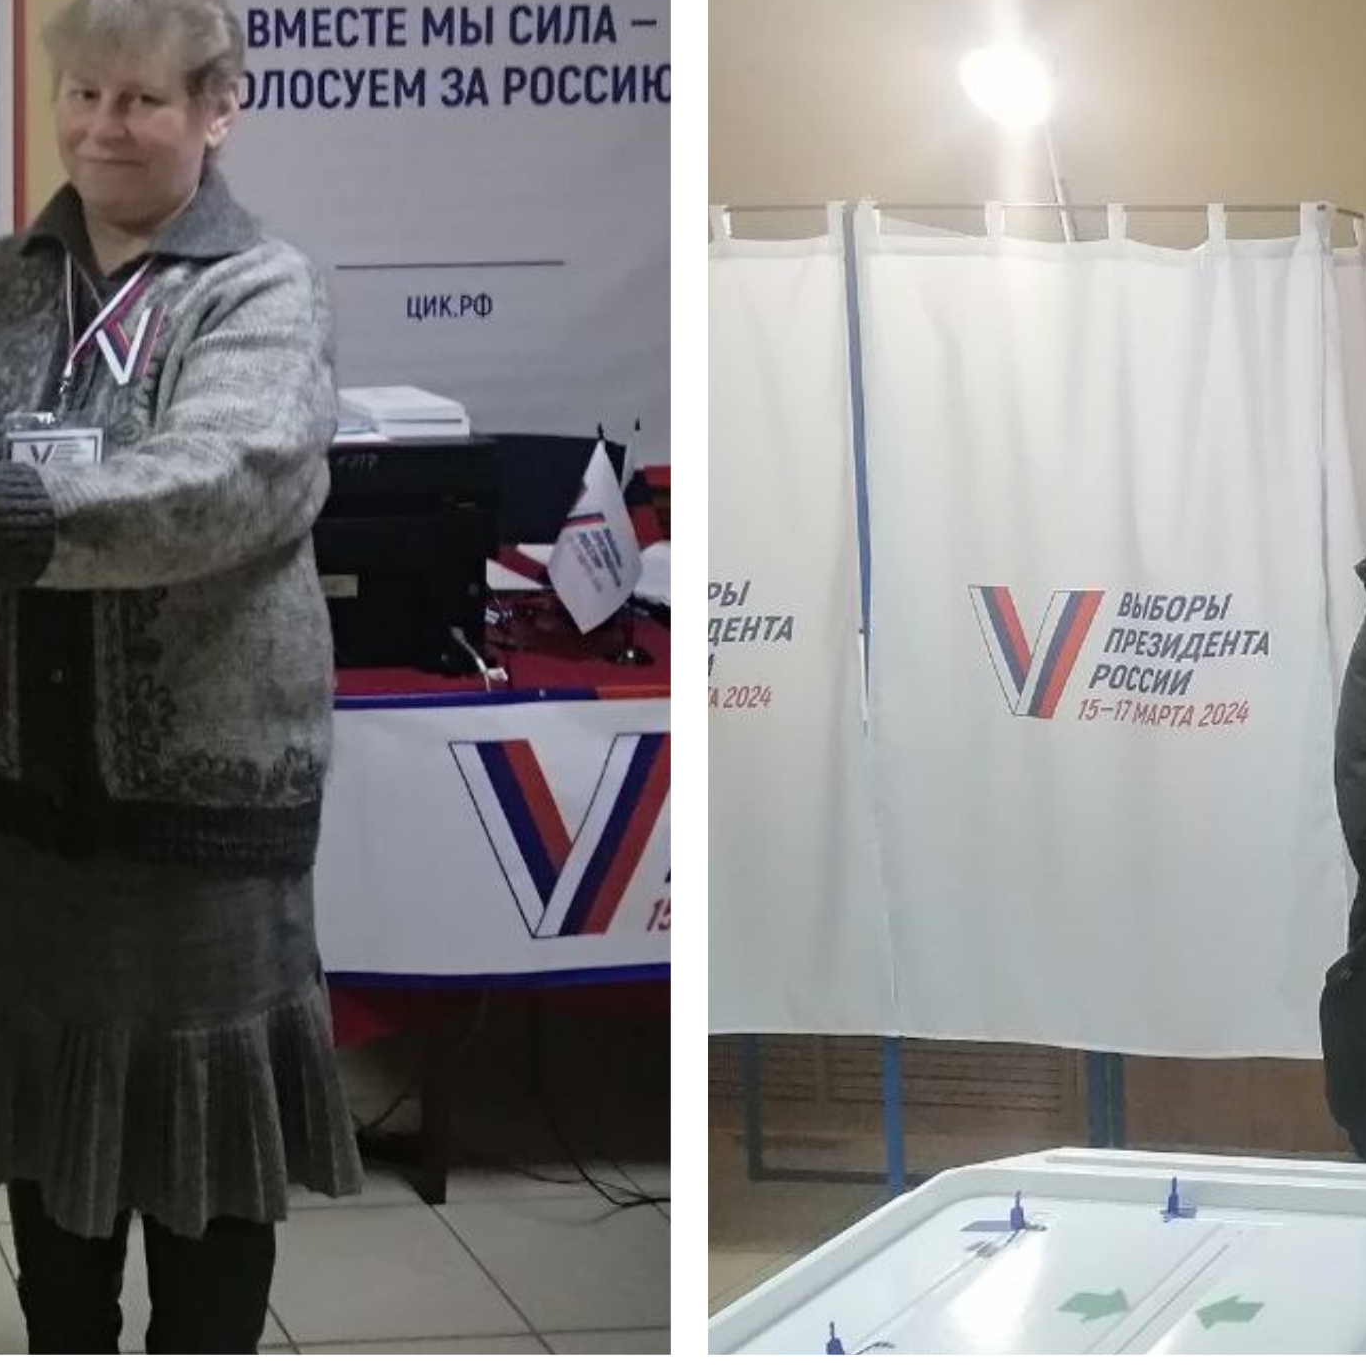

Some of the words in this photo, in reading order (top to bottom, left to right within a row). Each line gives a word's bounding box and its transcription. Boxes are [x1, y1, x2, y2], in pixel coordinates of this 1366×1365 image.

[247, 7, 407, 48] ВМЕСТЕ
[421, 6, 495, 46] МЫ
[508, 4, 617, 45] СИЛА
[238, 68, 426, 110] ОЛОСУЕМ
[440, 67, 489, 107] ЗА
[406, 292, 493, 321] ЦИК.РФ
[1117, 591, 1233, 621] ВЫБОРЫ
[1103, 627, 1270, 663] ПРЕЗИДЕНТА
[1088, 663, 1195, 695] РОССИИ
[723, 686, 772, 708] 2024
[1134, 701, 1195, 727] МАРТА
[1197, 700, 1249, 727] 2024
